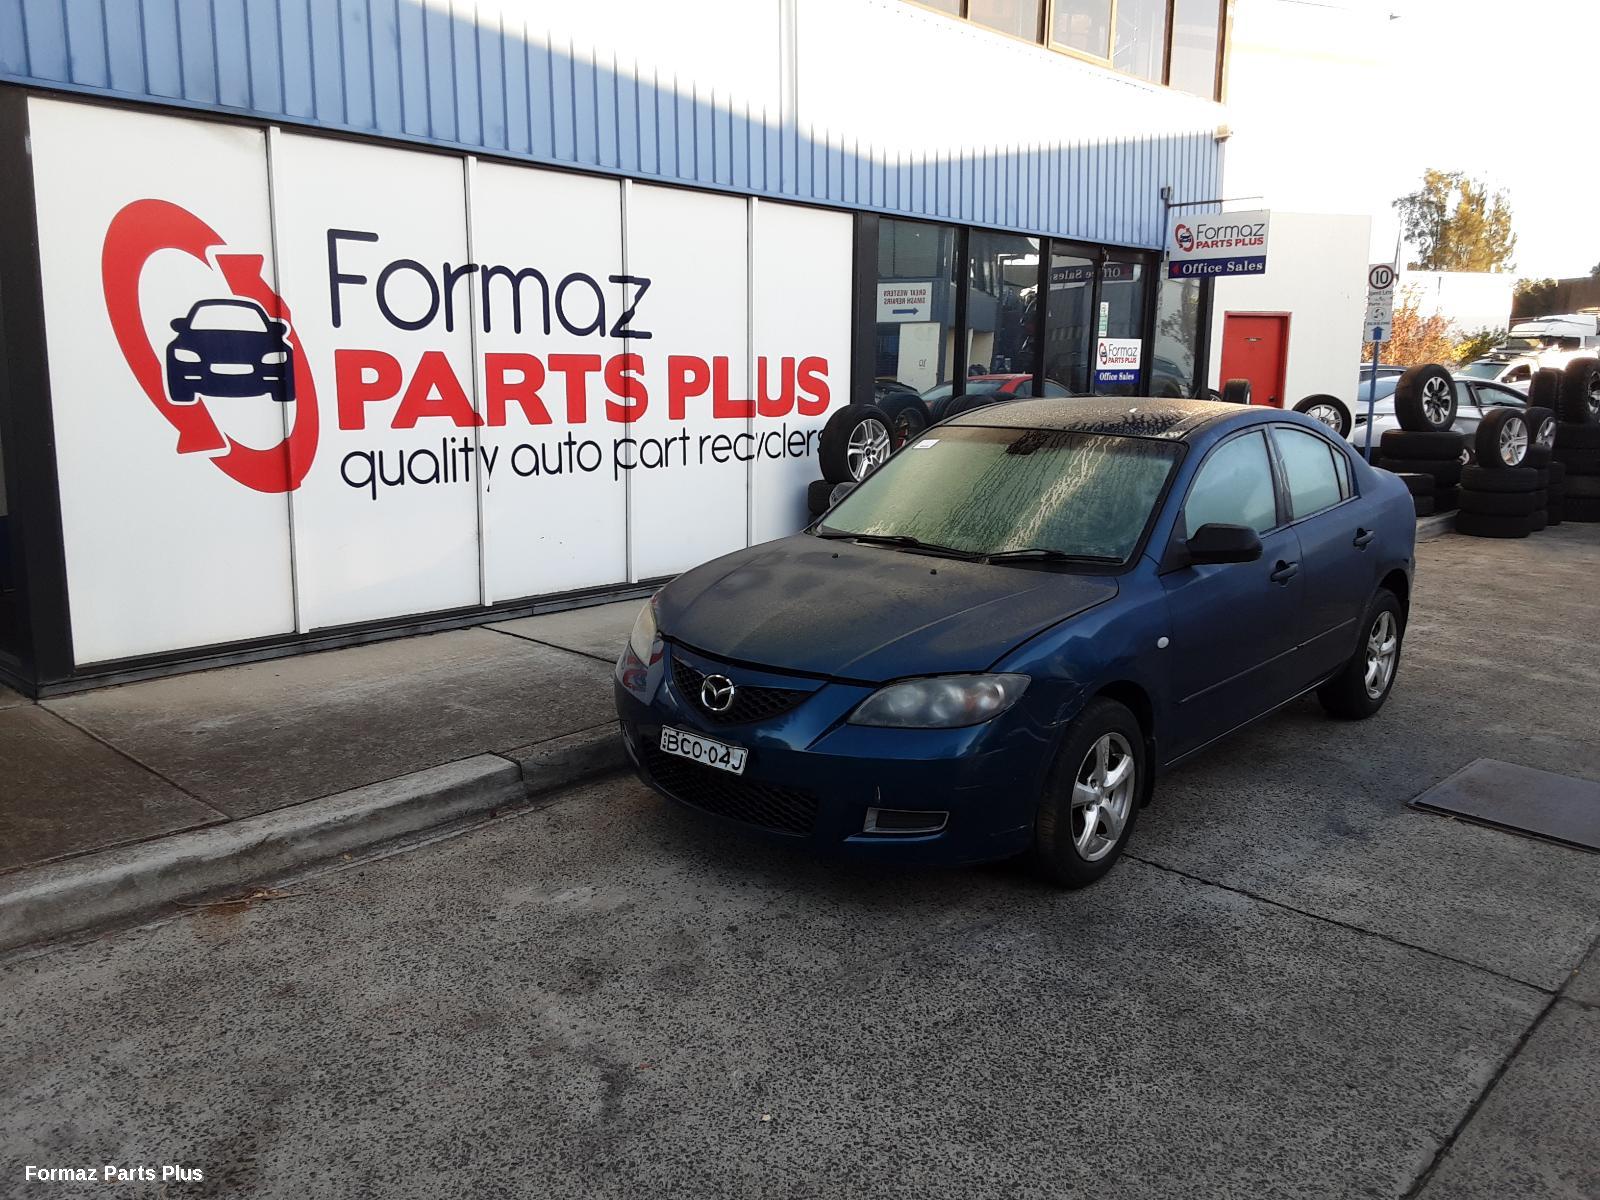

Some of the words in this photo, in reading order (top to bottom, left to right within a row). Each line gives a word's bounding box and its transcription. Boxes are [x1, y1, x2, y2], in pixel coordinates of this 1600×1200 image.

[1196, 223, 1265, 240] Formaz
[1196, 239, 1232, 249] PARTS
[1235, 236, 1264, 246] PLUS
[1182, 262, 1222, 274] Office
[1226, 260, 1263, 272] Sales
[327, 228, 653, 339] Formaz
[1375, 270, 1389, 285] 10
[1108, 344, 1138, 357] Formaz
[1099, 371, 1118, 381] Office
[1118, 371, 1135, 381] Sales
[335, 349, 648, 430] PARTS
[668, 355, 830, 419] PLUS
[340, 437, 499, 501] quality
[511, 430, 602, 477] auto
[613, 427, 690, 481] part
